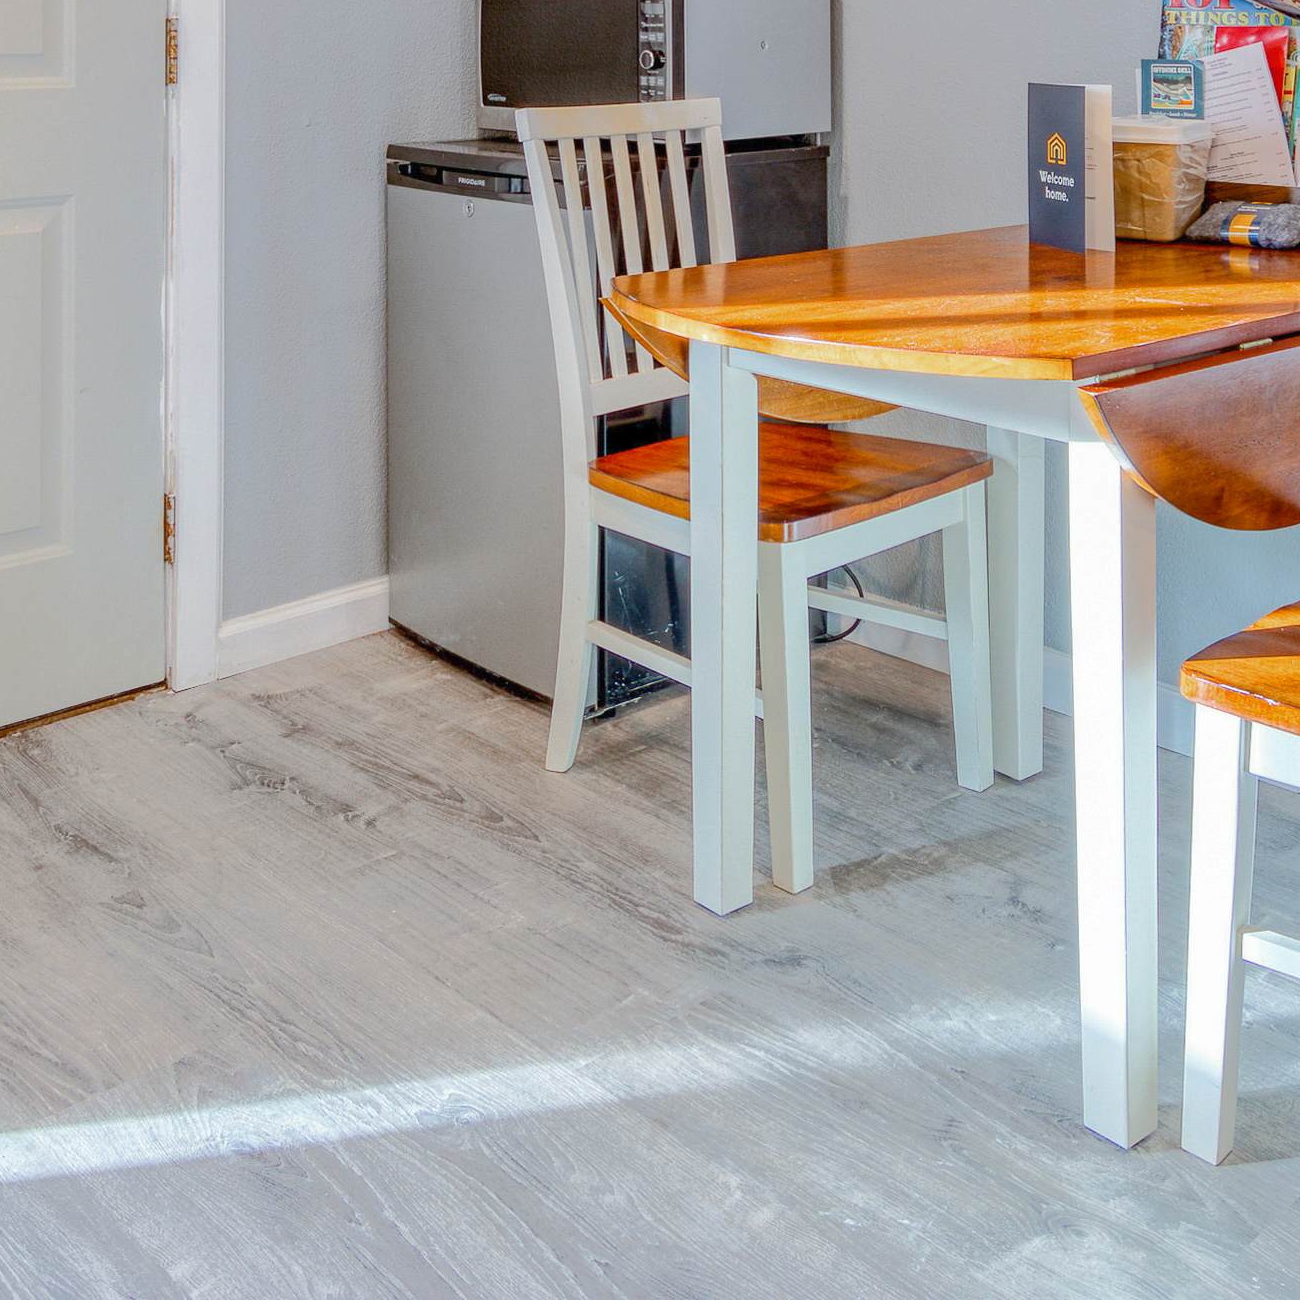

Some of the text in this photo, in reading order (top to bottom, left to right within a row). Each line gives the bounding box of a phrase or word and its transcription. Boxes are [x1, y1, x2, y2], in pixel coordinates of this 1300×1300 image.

[1165, 11, 1250, 26] THINGS
[1255, 12, 1286, 26] TO
[1039, 169, 1075, 188] Welcome
[1045, 185, 1070, 202] home.
